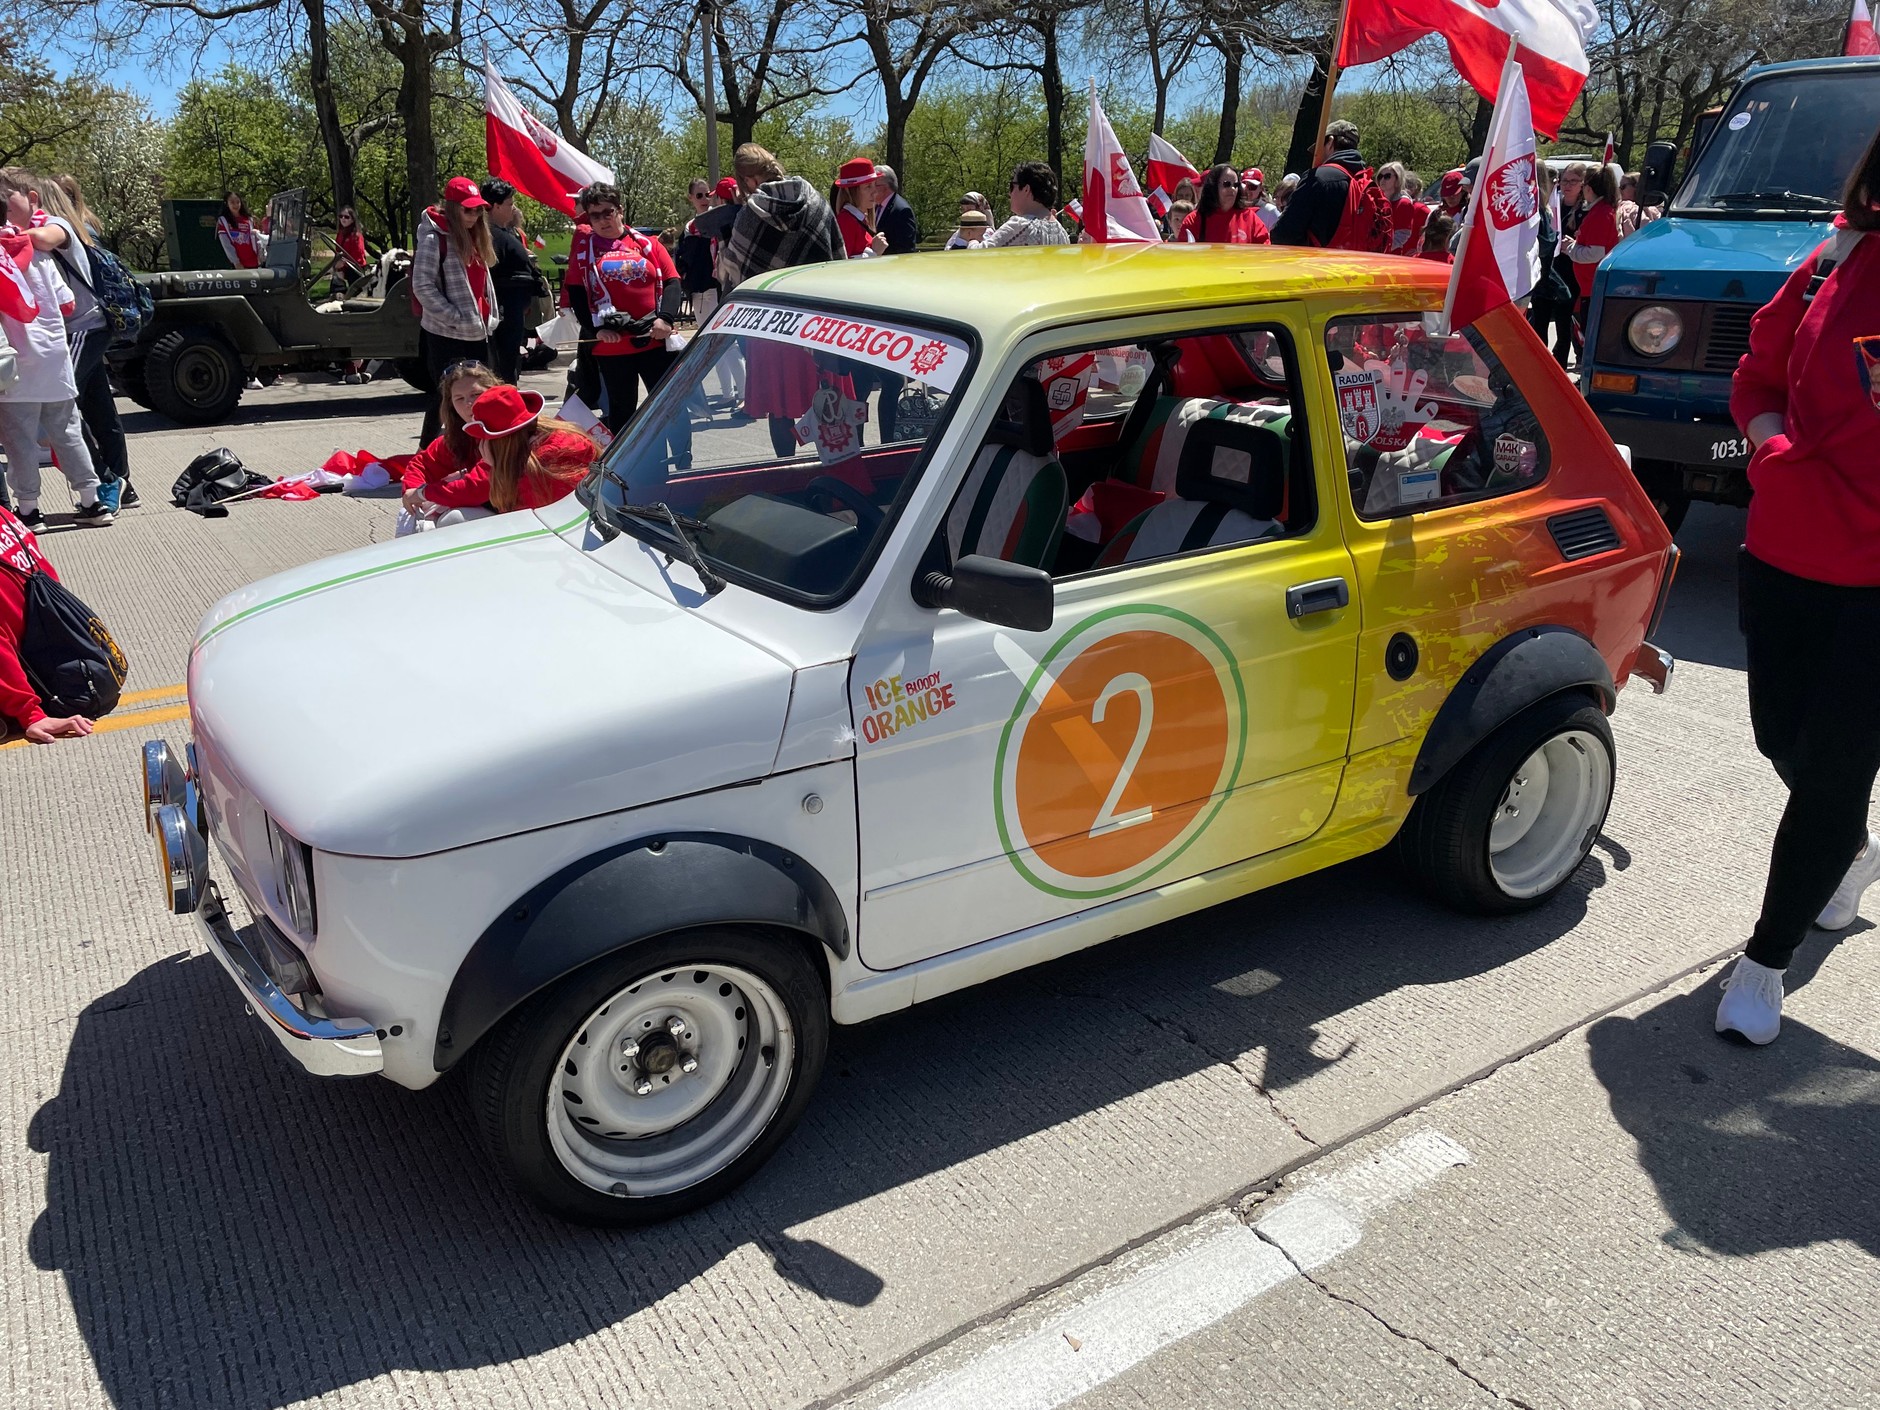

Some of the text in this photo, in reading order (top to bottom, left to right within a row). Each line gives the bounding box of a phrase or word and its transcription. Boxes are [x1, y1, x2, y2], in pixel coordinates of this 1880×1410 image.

[183, 280, 240, 291] 677666
[723, 307, 770, 331] AUTA
[763, 311, 804, 336] PRL
[799, 316, 914, 361] CHICAGO
[1338, 372, 1373, 385] RADOM
[1370, 436, 1407, 447] POLSKA
[1496, 442, 1518, 454] M4K
[865, 671, 941, 711] ICE BLOODY
[862, 684, 955, 744] ORANGE
[1088, 672, 1154, 838] 2
